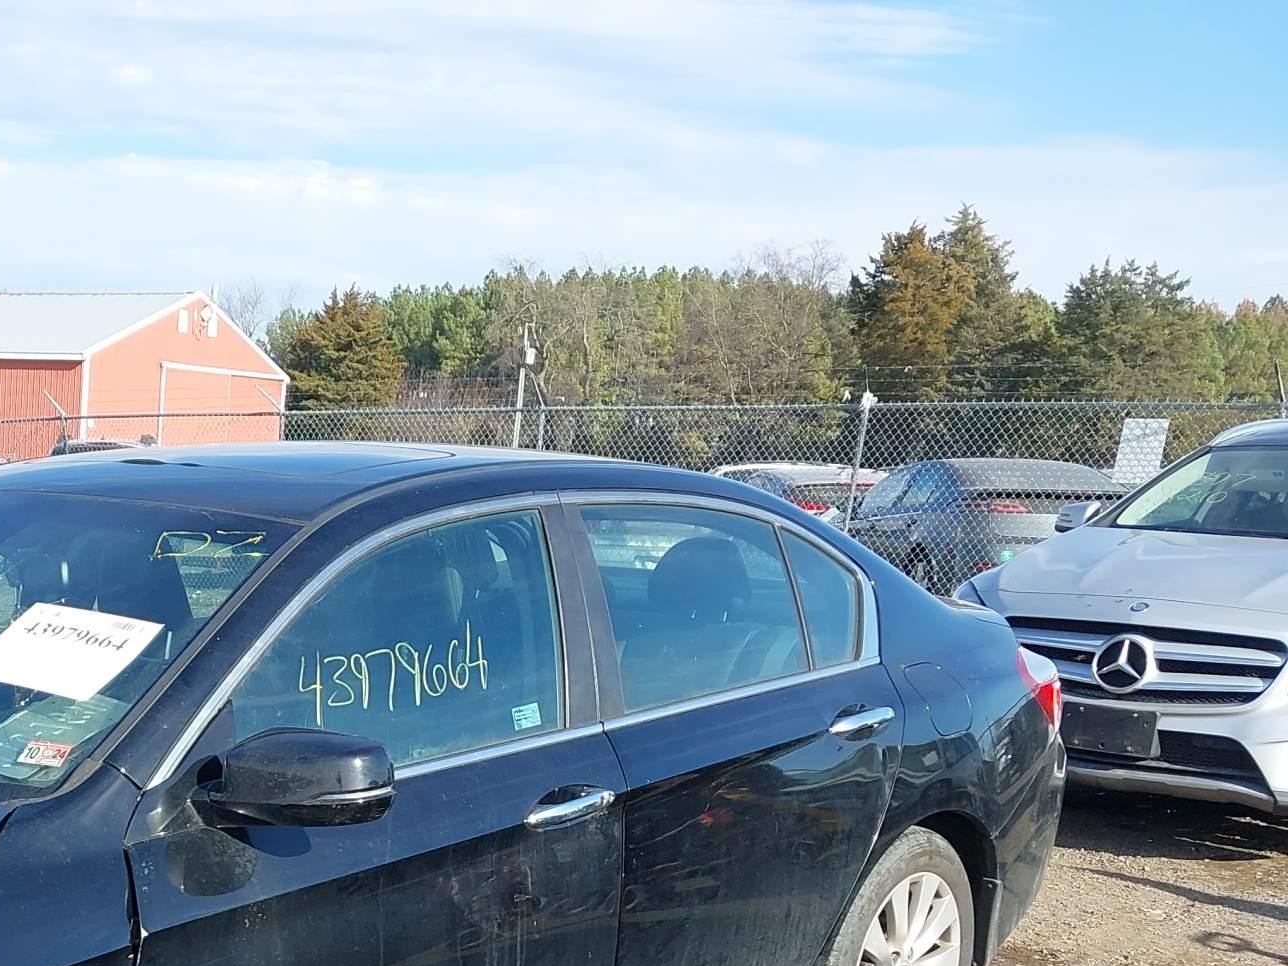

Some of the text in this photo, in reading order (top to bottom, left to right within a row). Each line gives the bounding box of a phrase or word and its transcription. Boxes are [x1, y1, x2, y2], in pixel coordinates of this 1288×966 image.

[24, 621, 131, 652] 43979664
[299, 619, 488, 726] 43979664
[24, 746, 68, 760] 10 24
